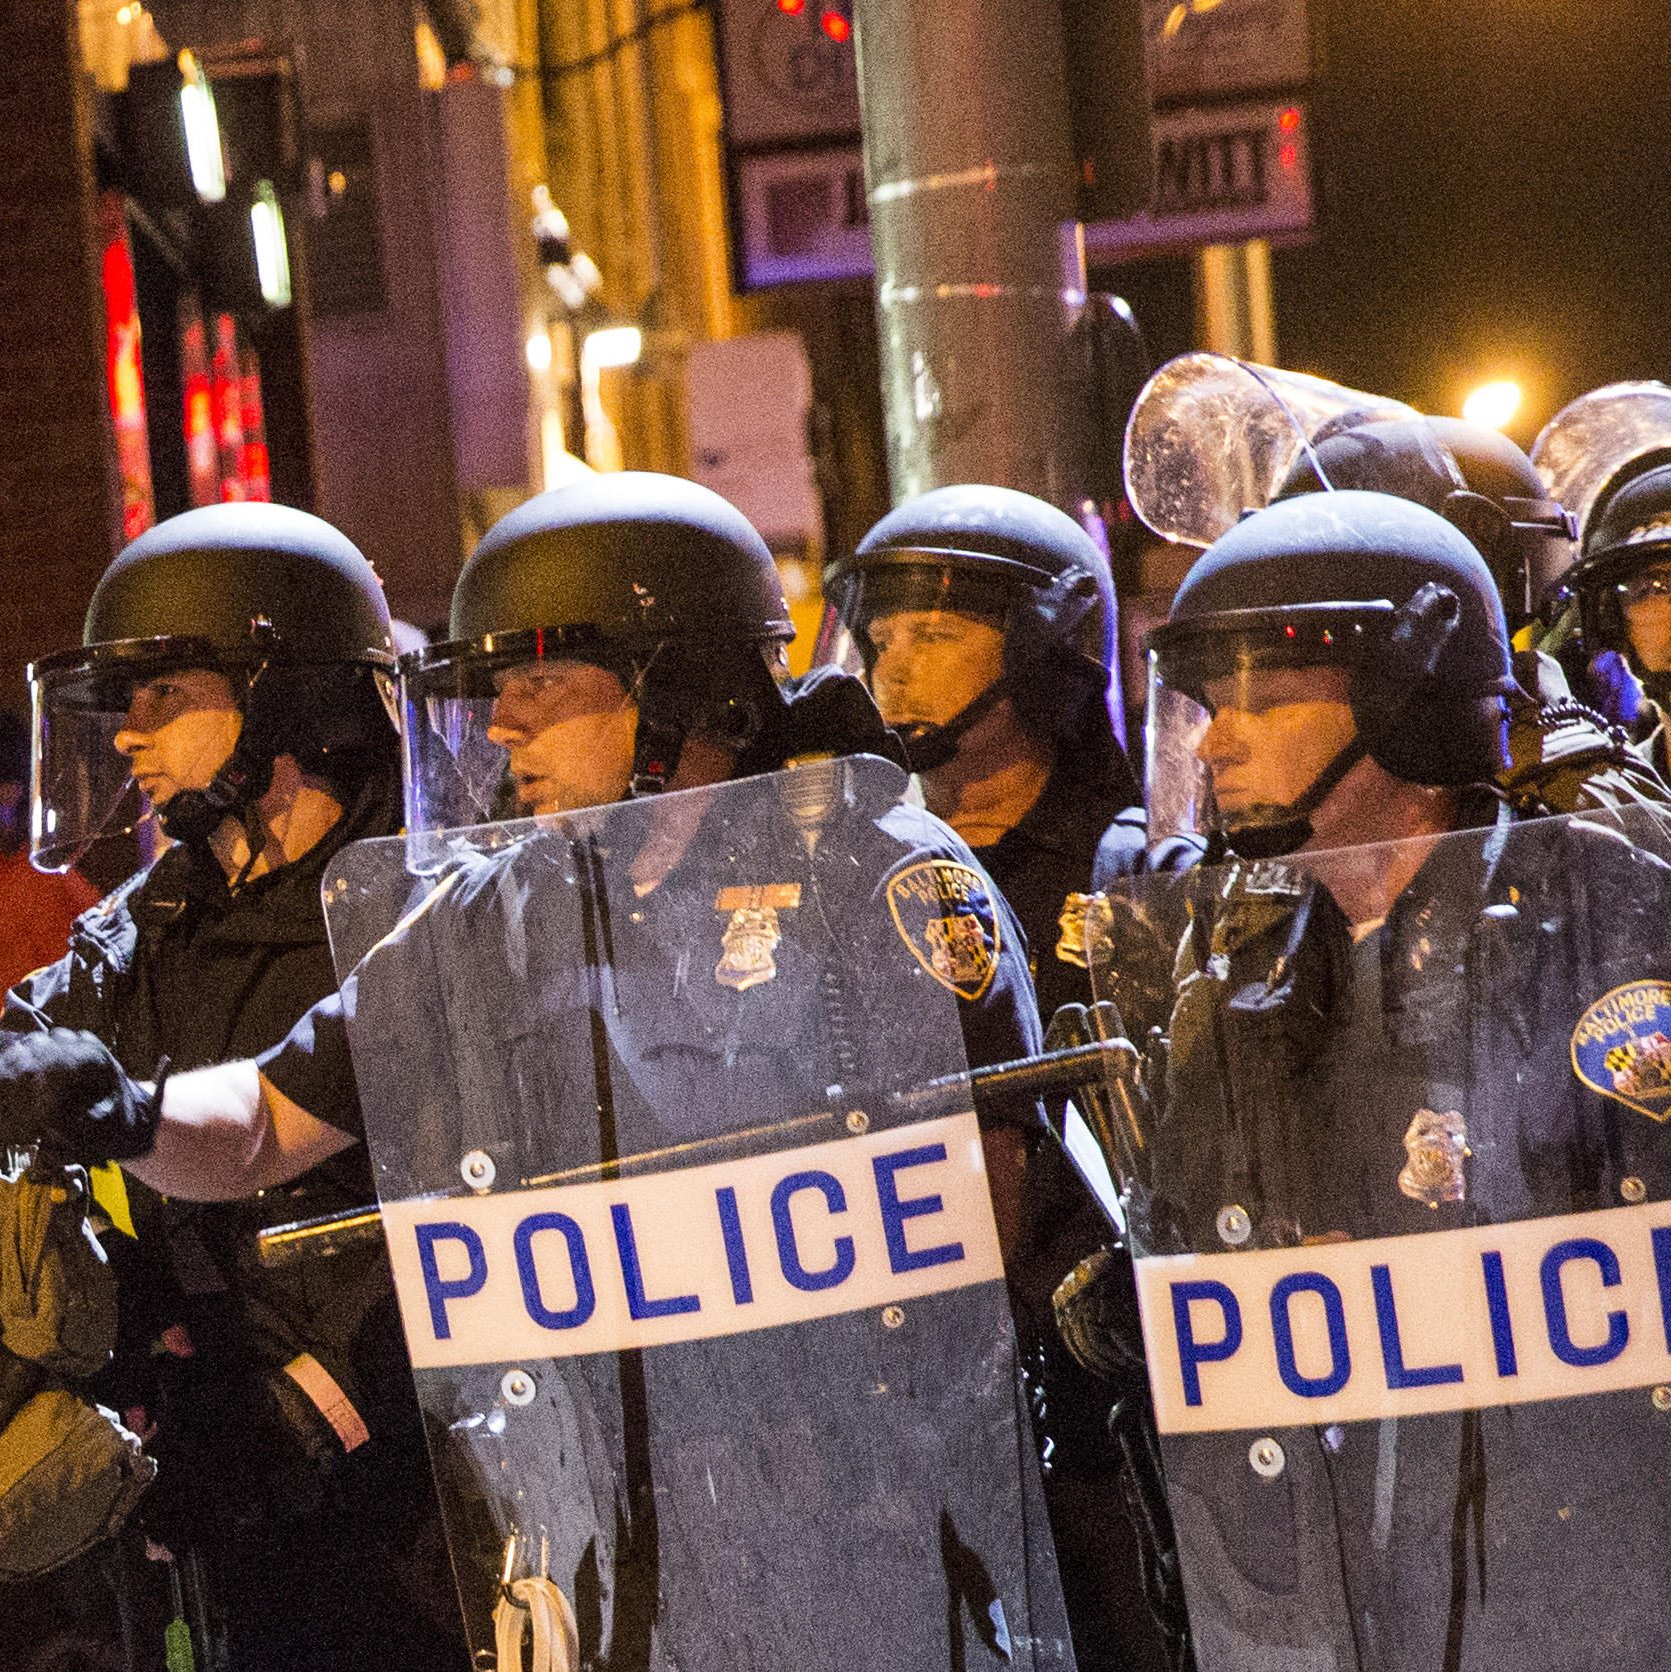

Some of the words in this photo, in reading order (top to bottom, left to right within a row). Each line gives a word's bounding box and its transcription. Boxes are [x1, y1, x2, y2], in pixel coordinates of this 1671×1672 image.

[894, 867, 980, 900] BALTIMORE
[918, 882, 970, 906] POLICE
[1593, 1003, 1657, 1043] POLICE
[414, 1142, 966, 1341] POLICE
